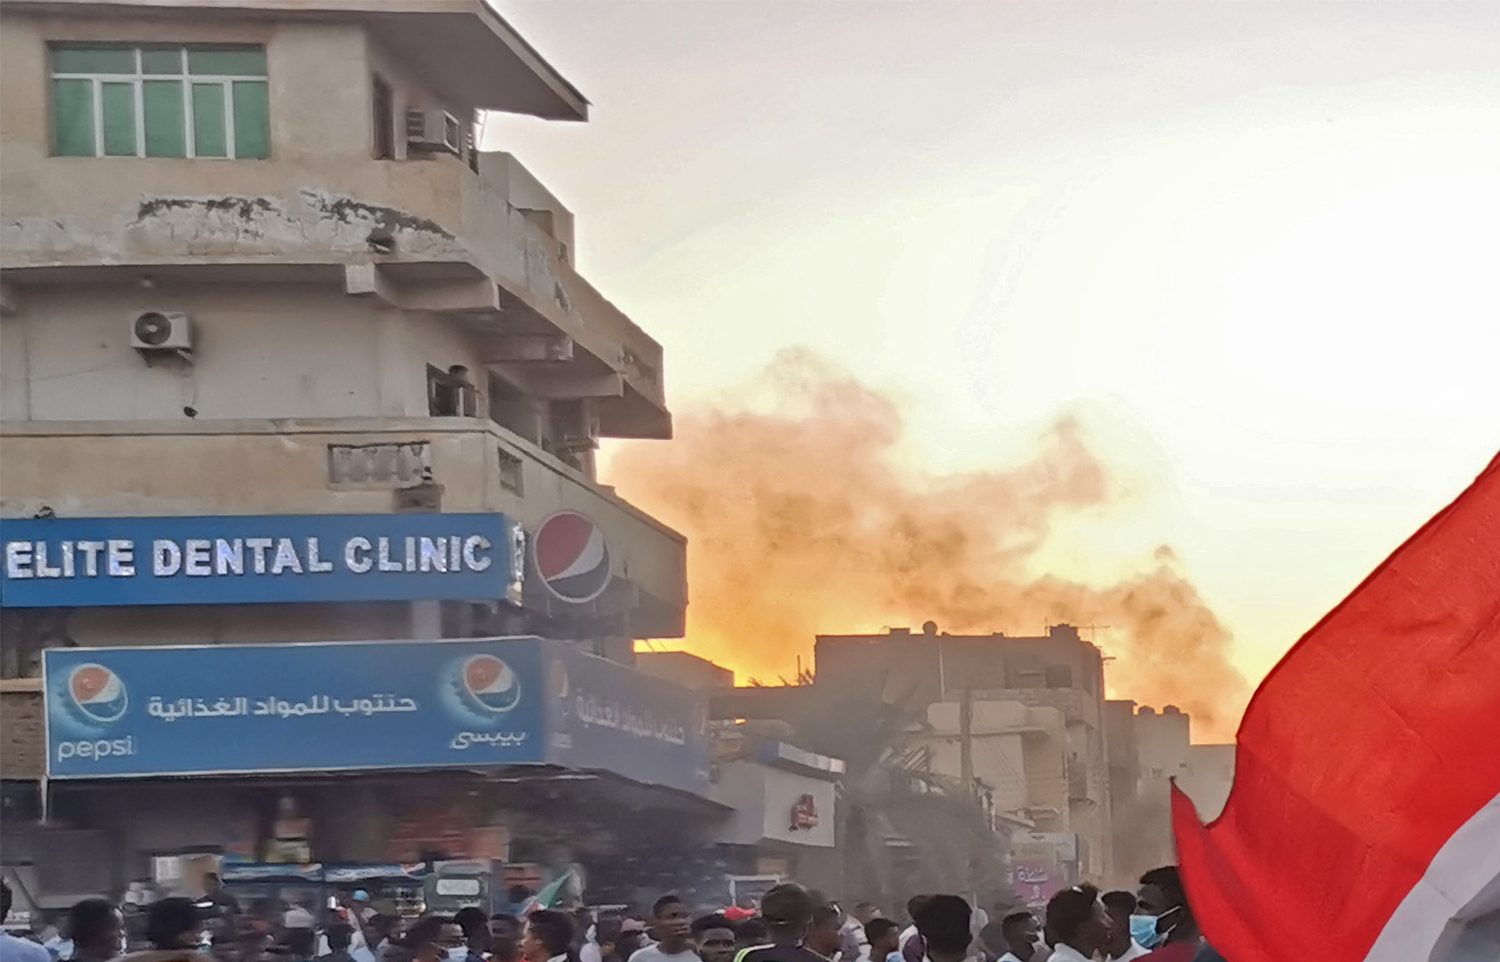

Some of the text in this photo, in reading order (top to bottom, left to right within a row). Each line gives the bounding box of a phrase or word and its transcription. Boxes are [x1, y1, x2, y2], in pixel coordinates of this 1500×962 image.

[6, 539, 137, 580] ELITE
[152, 537, 333, 577] DENTAL
[344, 535, 492, 574] CLINIC
[148, 692, 418, 723] حنتوب للمواد الغذائية
[57, 735, 133, 762] pepsi
